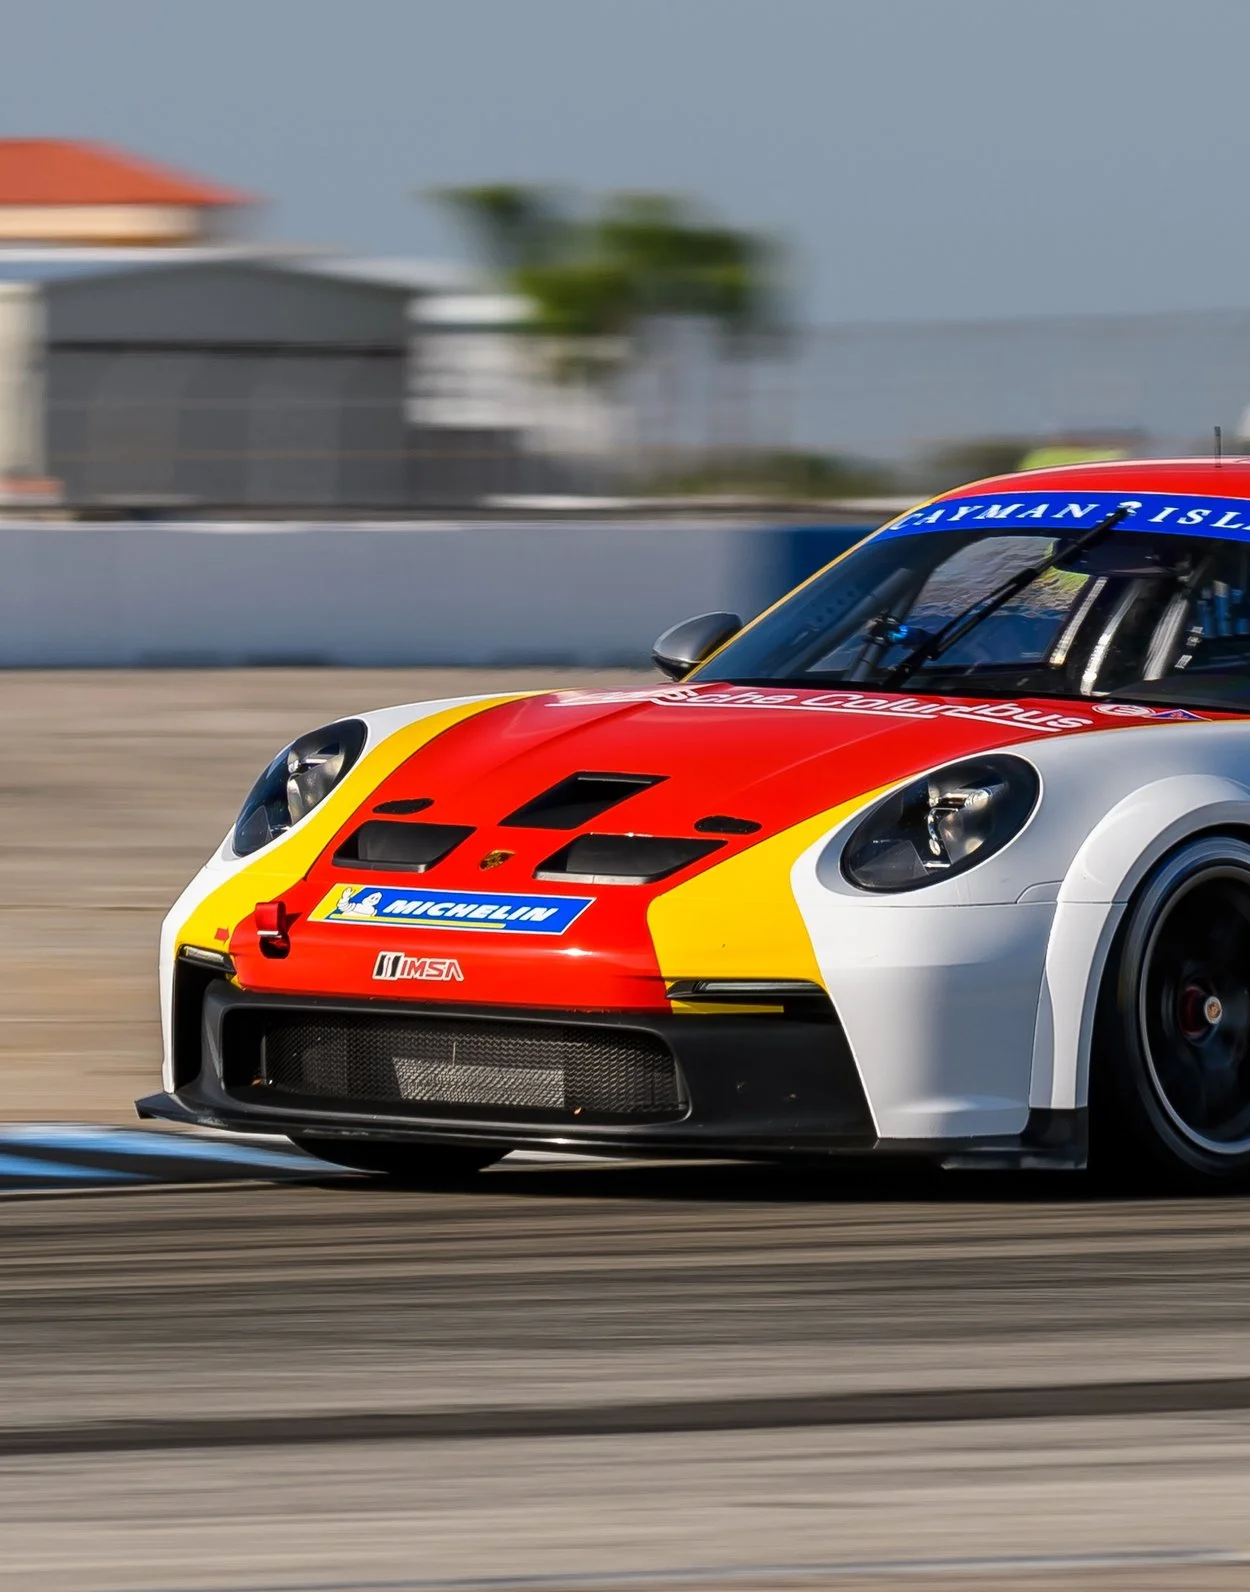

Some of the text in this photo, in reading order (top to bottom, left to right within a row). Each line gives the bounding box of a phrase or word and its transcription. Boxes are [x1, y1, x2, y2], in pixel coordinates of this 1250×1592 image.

[889, 502, 1100, 531] CAYMAN
[382, 899, 560, 922] MICHELIN
[399, 956, 464, 982] IMSA
